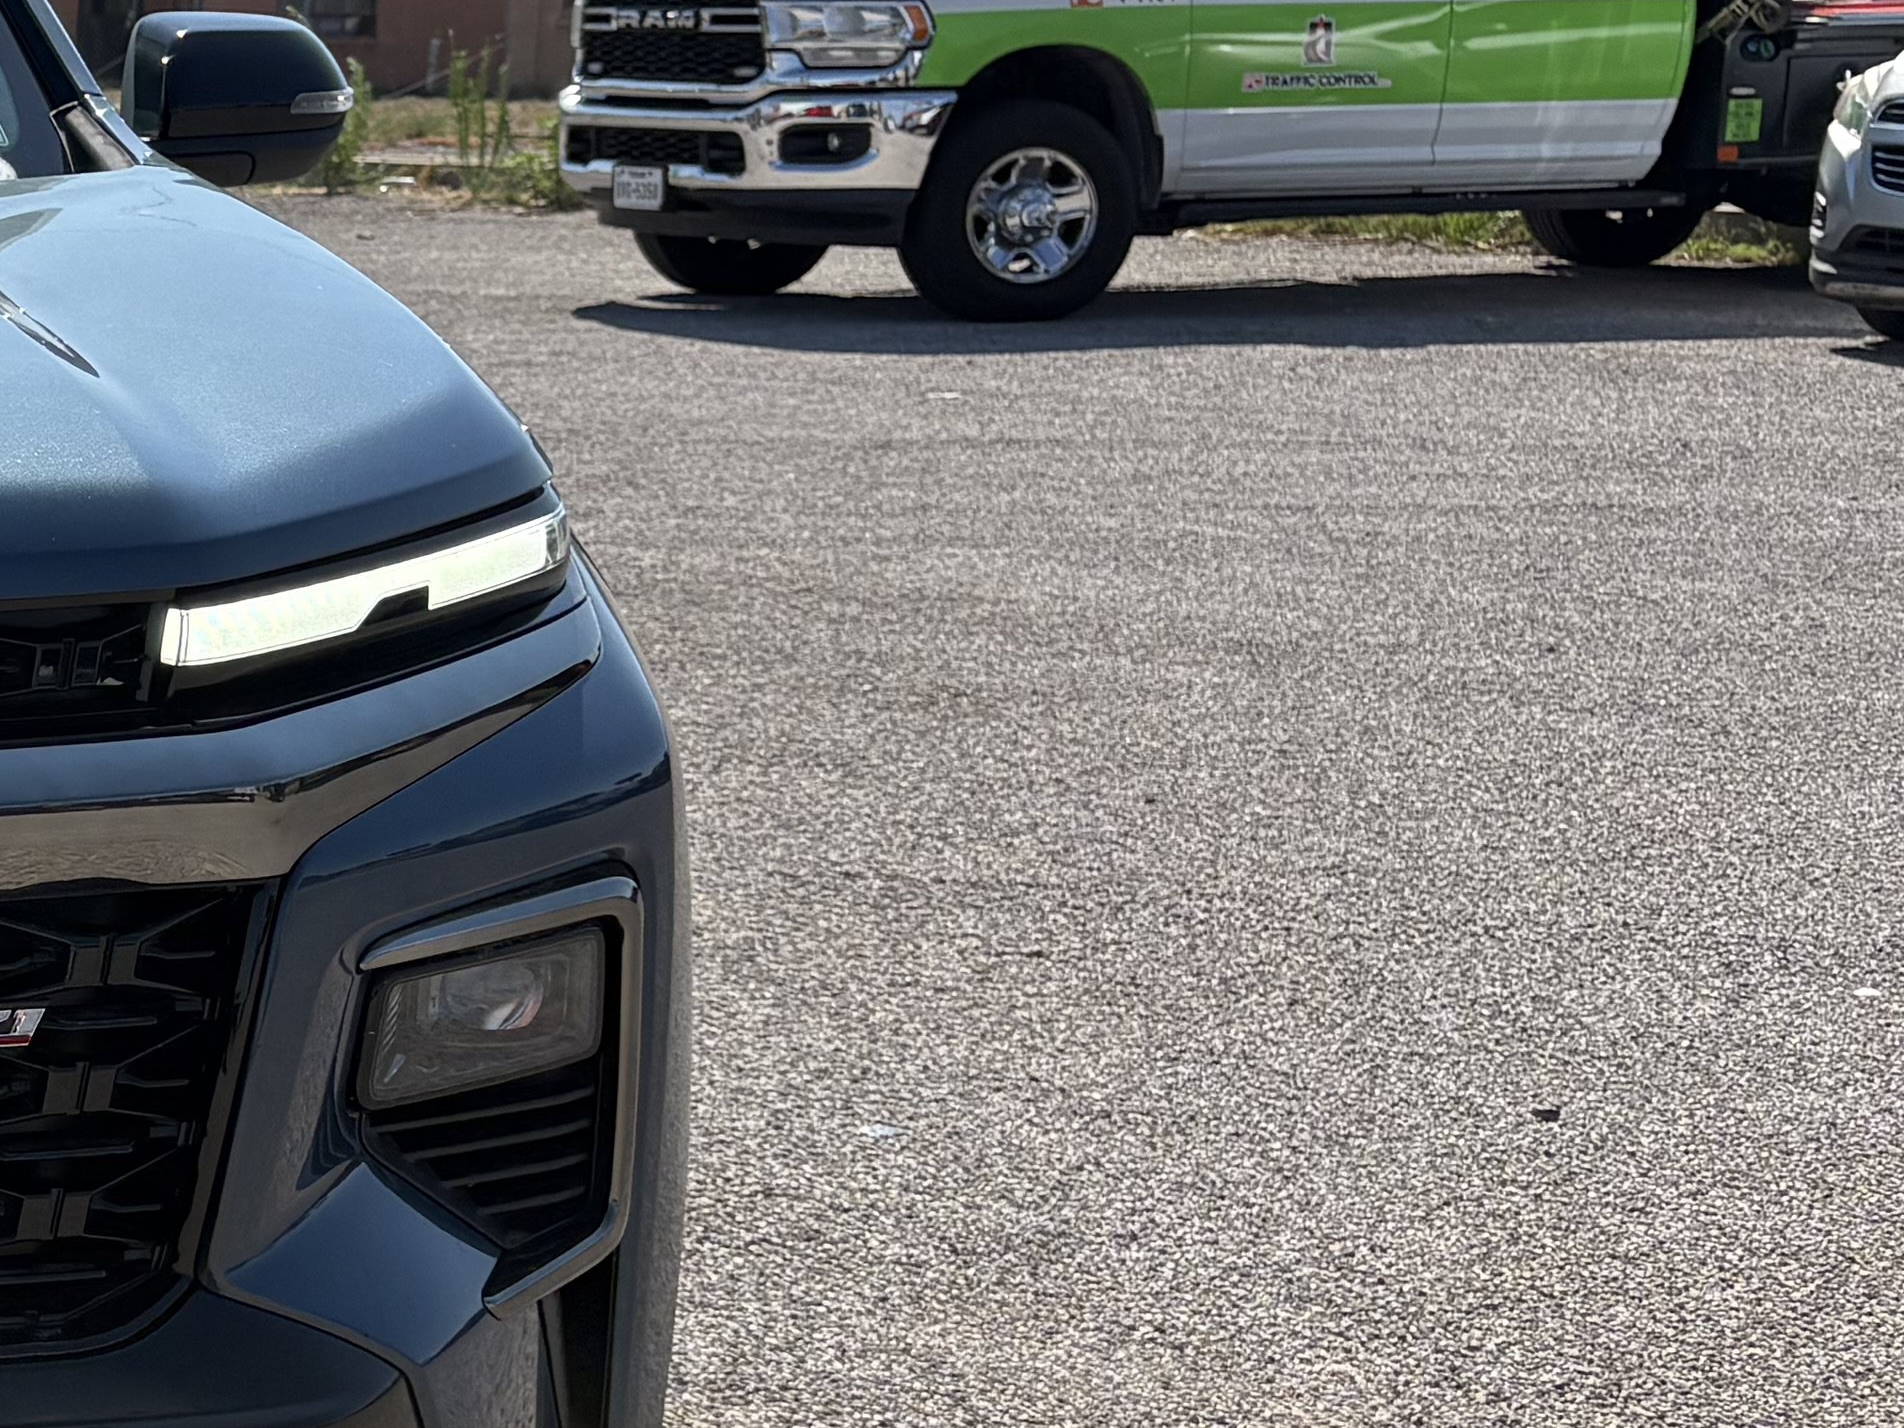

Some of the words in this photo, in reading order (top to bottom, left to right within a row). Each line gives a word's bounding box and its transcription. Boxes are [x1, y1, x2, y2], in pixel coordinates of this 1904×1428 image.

[616, 9, 696, 29] RAM
[1264, 74, 1316, 88] TRAFFIC
[1318, 73, 1378, 87] CONTROL
